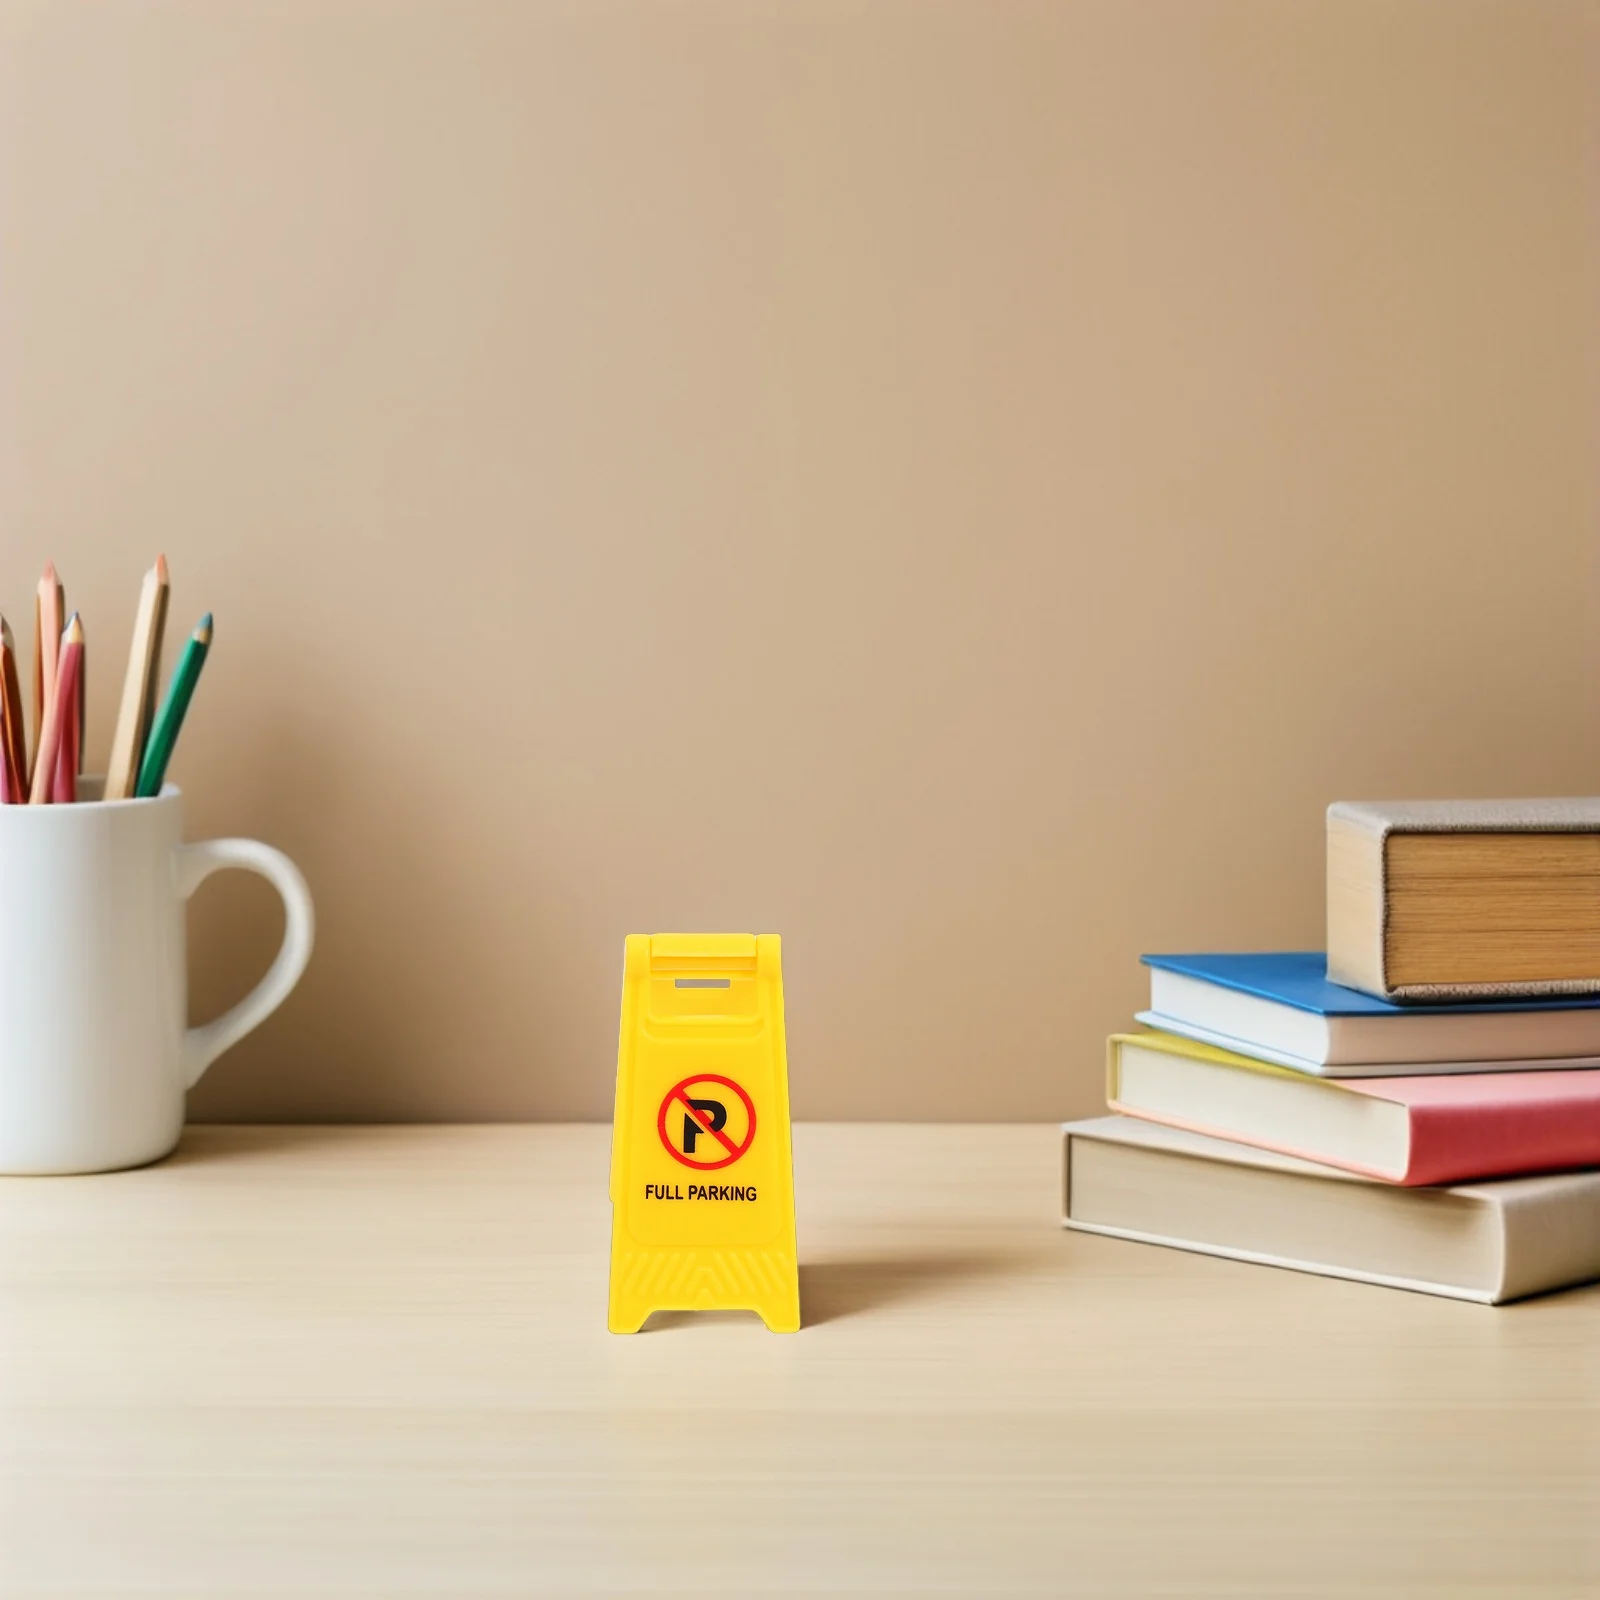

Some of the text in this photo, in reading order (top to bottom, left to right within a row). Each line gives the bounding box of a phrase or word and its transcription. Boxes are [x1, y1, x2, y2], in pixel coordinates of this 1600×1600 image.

[683, 1099, 727, 1154] P
[645, 1184, 757, 1202] FULL PARKING
